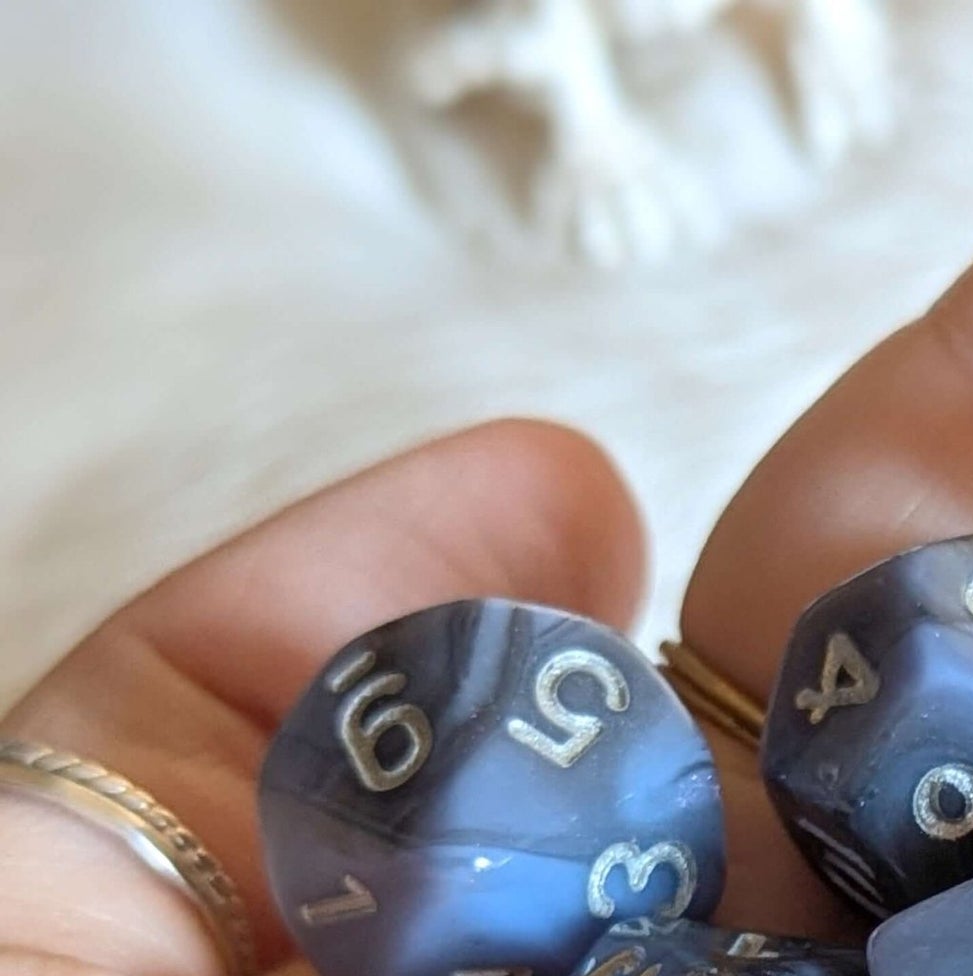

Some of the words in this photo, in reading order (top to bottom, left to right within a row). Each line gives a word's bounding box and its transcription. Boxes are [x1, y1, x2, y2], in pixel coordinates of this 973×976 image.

[507, 649, 631, 769] 5
[795, 632, 880, 726] 4
[302, 873, 378, 927] 1
[587, 840, 698, 920] 3
